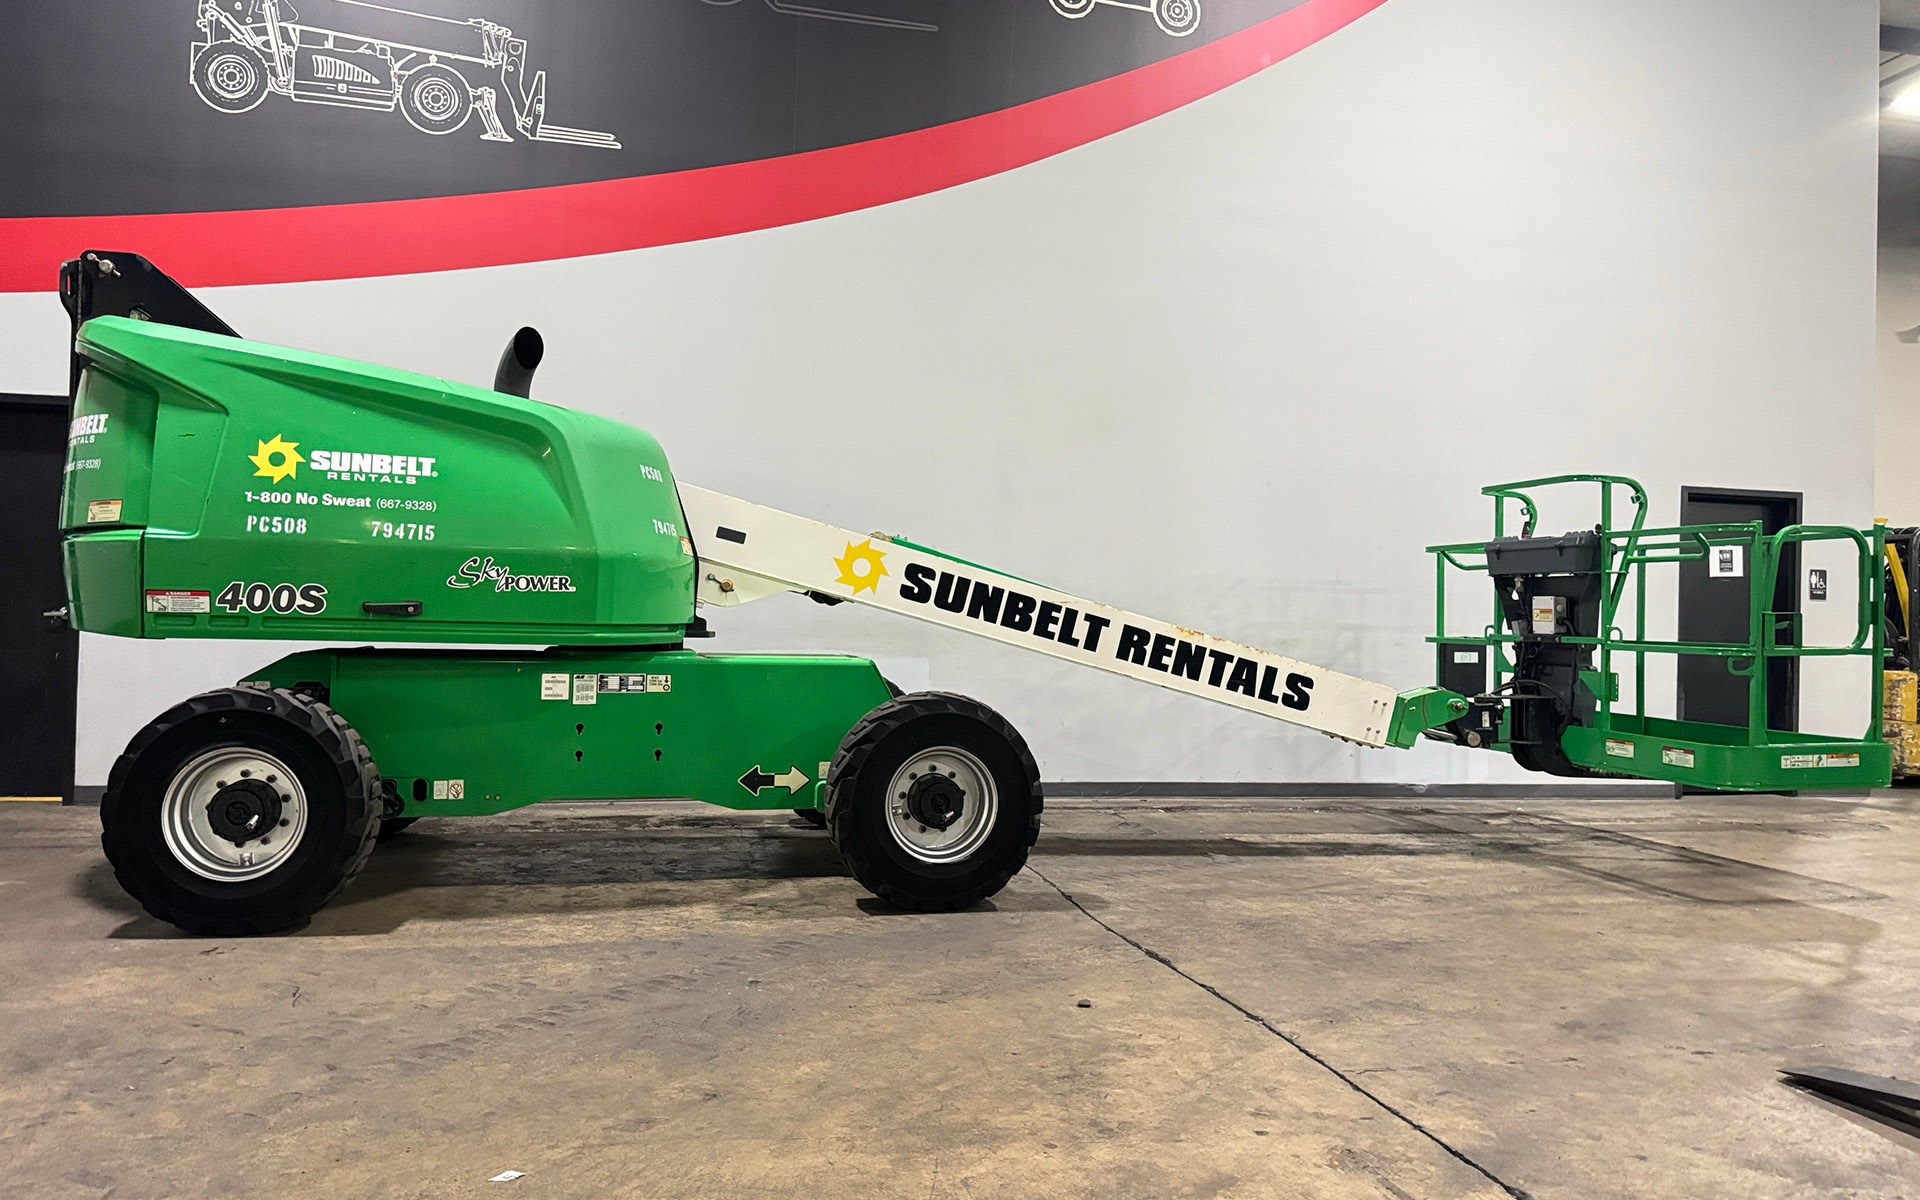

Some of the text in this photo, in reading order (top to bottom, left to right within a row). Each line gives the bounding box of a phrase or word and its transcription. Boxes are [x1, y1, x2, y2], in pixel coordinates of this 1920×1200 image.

[310, 450, 436, 476] SUNBELT
[327, 471, 416, 484] RENTALS
[245, 491, 437, 512] 1-800 No Sweat (667-9328)
[246, 515, 307, 534] PC508
[371, 521, 435, 540] 794715
[215, 581, 328, 615] 400S
[899, 562, 1314, 711] SUNBELT RENTALS
